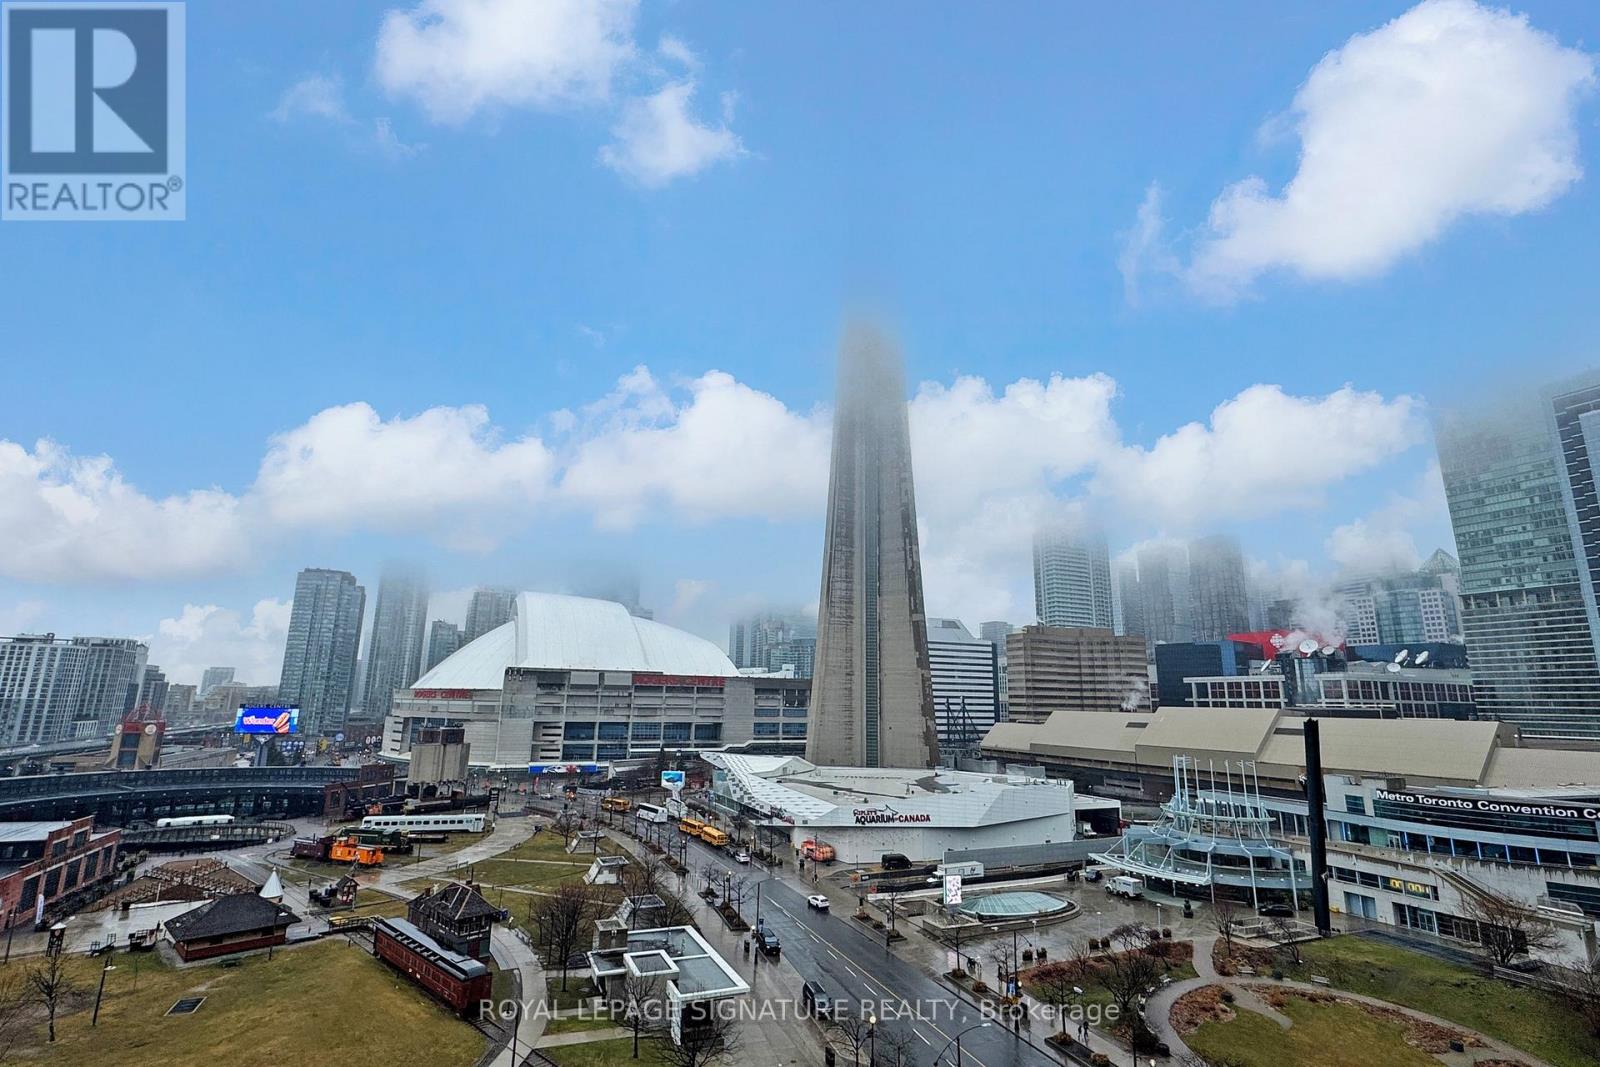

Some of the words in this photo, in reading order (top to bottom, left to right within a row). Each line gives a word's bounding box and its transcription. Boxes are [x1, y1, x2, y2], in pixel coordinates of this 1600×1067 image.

[1376, 790, 1415, 803] Metro
[1416, 794, 1473, 809] Toronto
[1477, 801, 1578, 818] Convention
[855, 813, 895, 825] AQUARIUM
[898, 814, 931, 823] CANADA
